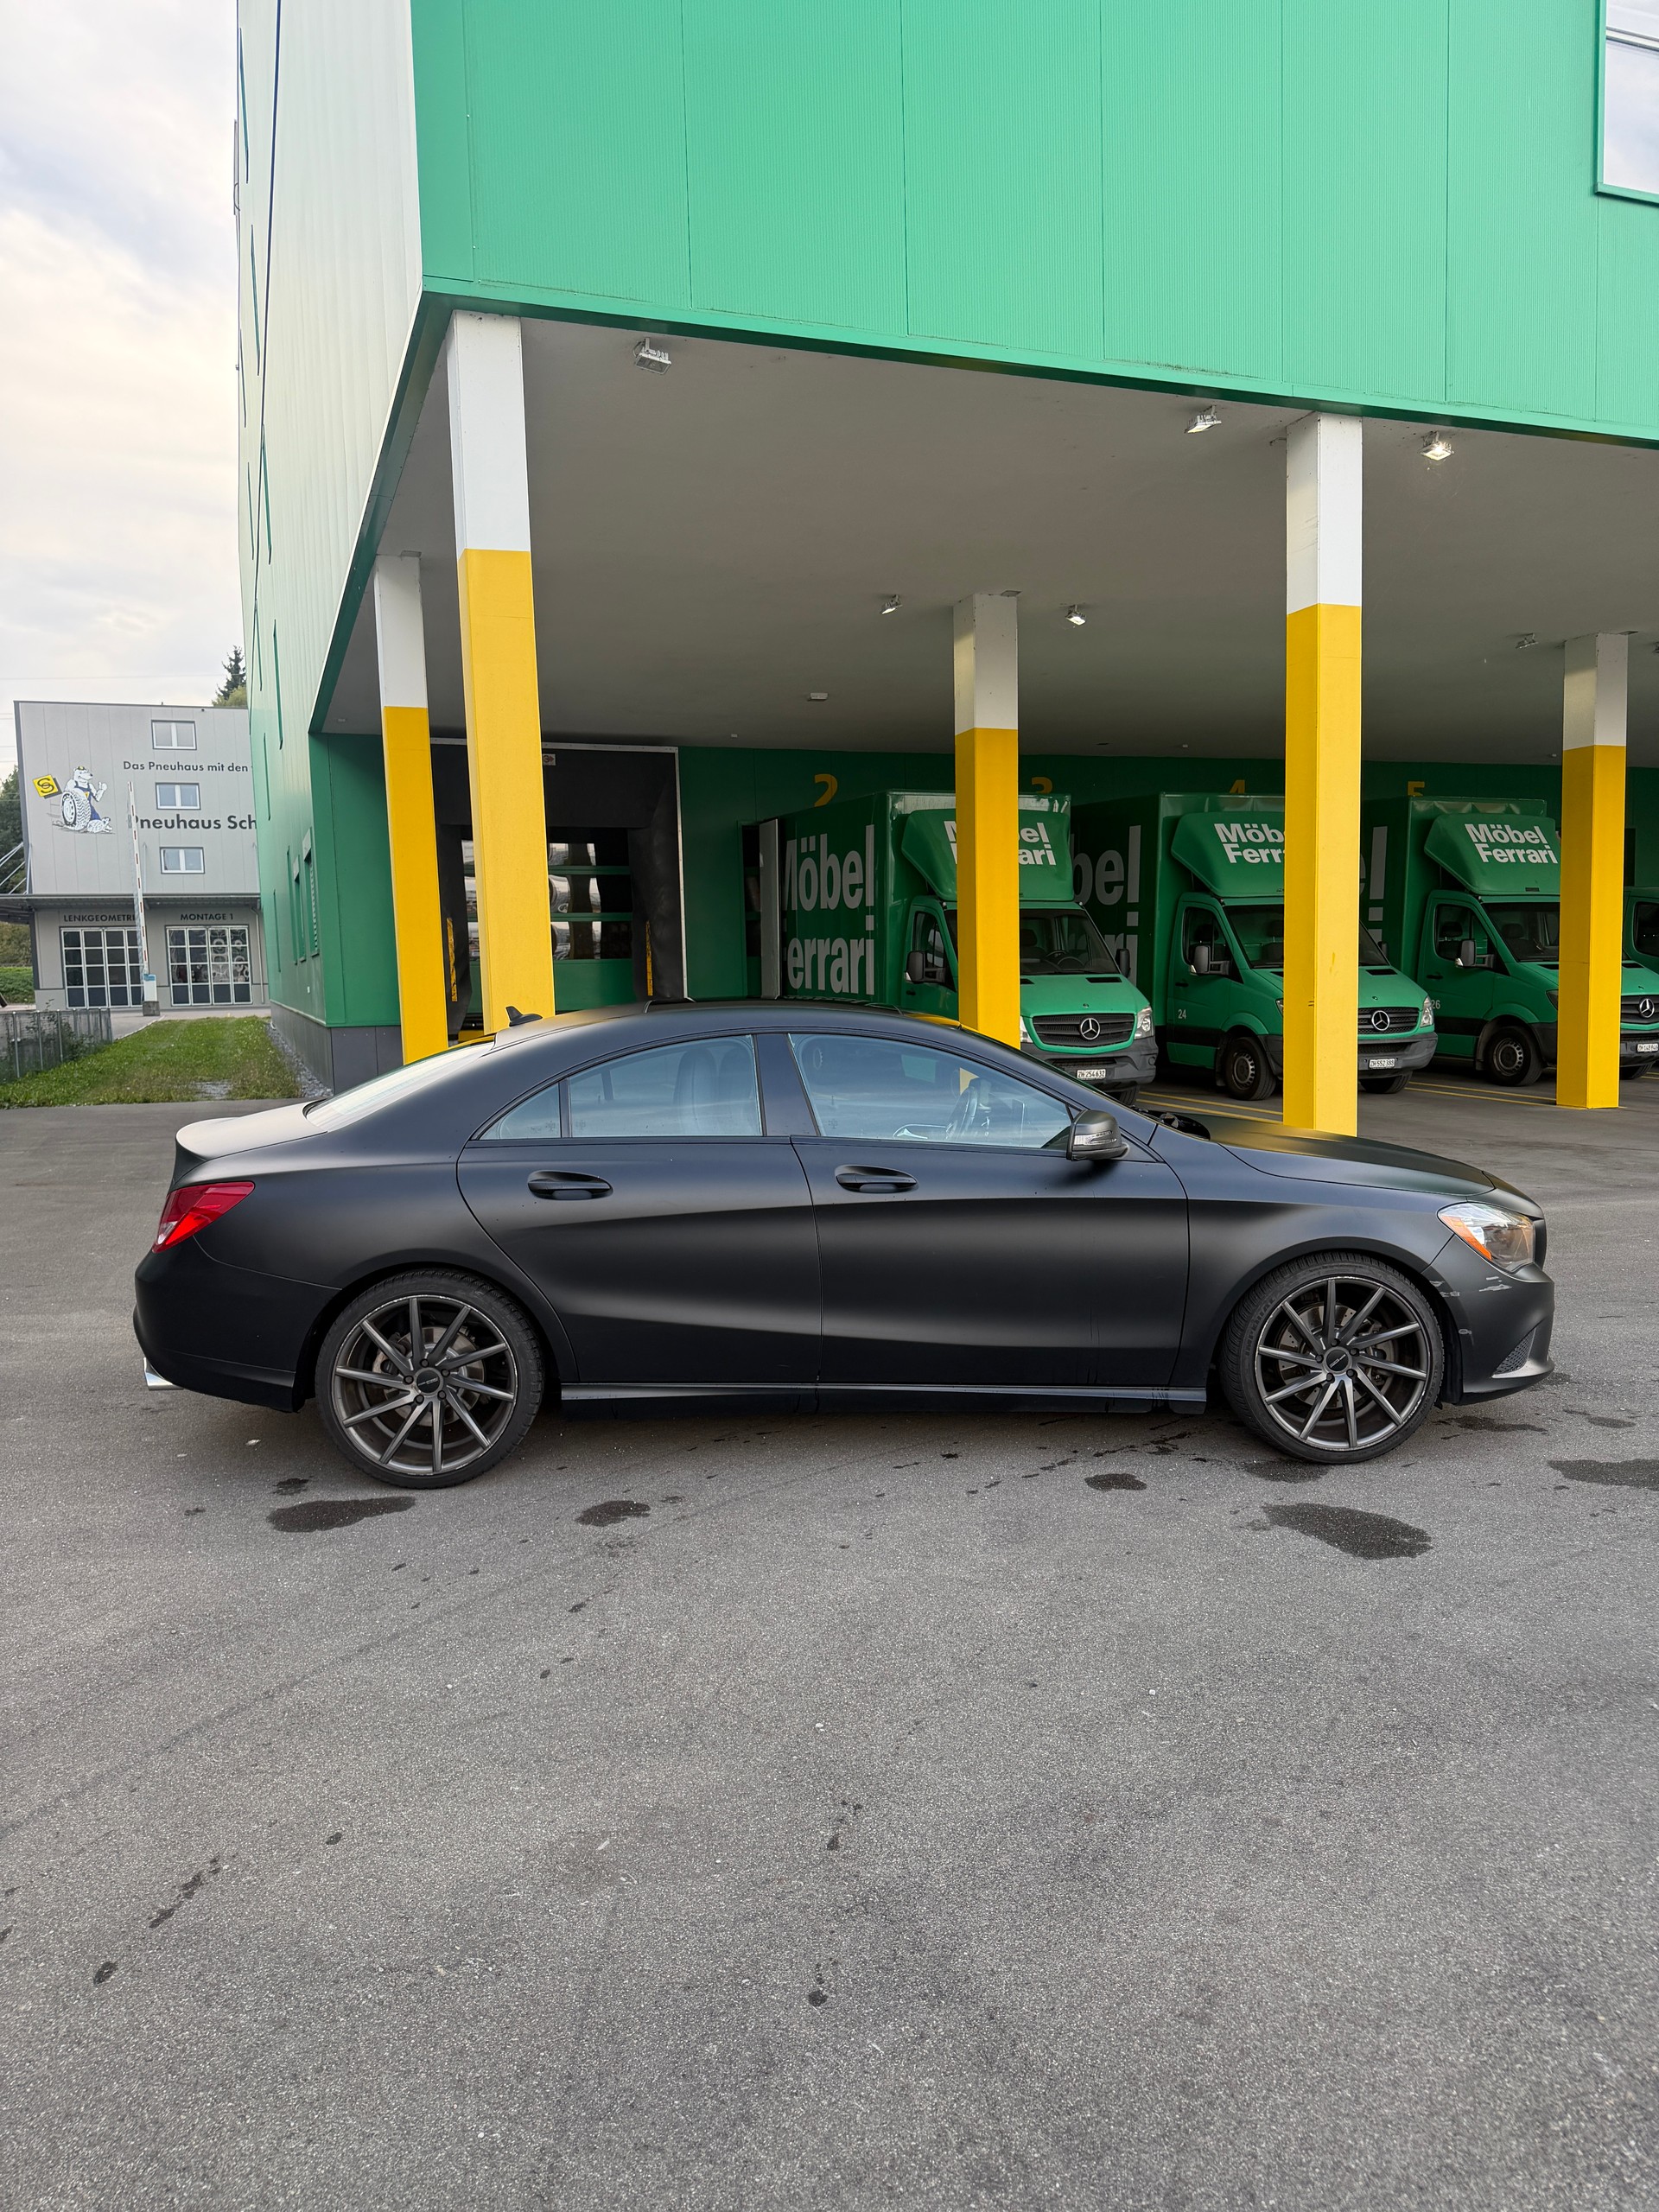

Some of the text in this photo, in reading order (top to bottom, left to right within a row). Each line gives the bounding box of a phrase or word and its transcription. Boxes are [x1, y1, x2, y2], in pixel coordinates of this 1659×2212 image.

[123, 761, 248, 772] Das Pneuhaus mit den
[227, 814, 257, 830] Sch
[1214, 823, 1285, 843] Möb
[1465, 823, 1548, 844] Möbel
[1223, 843, 1285, 864] Ferr
[1474, 843, 1559, 864] Ferrari
[1071, 824, 1141, 906] bel
[63, 913, 136, 923] LENKGEOMETRI
[784, 915, 874, 995] errari
[1178, 1008, 1187, 1020] 24
[1431, 999, 1440, 1009] 26
